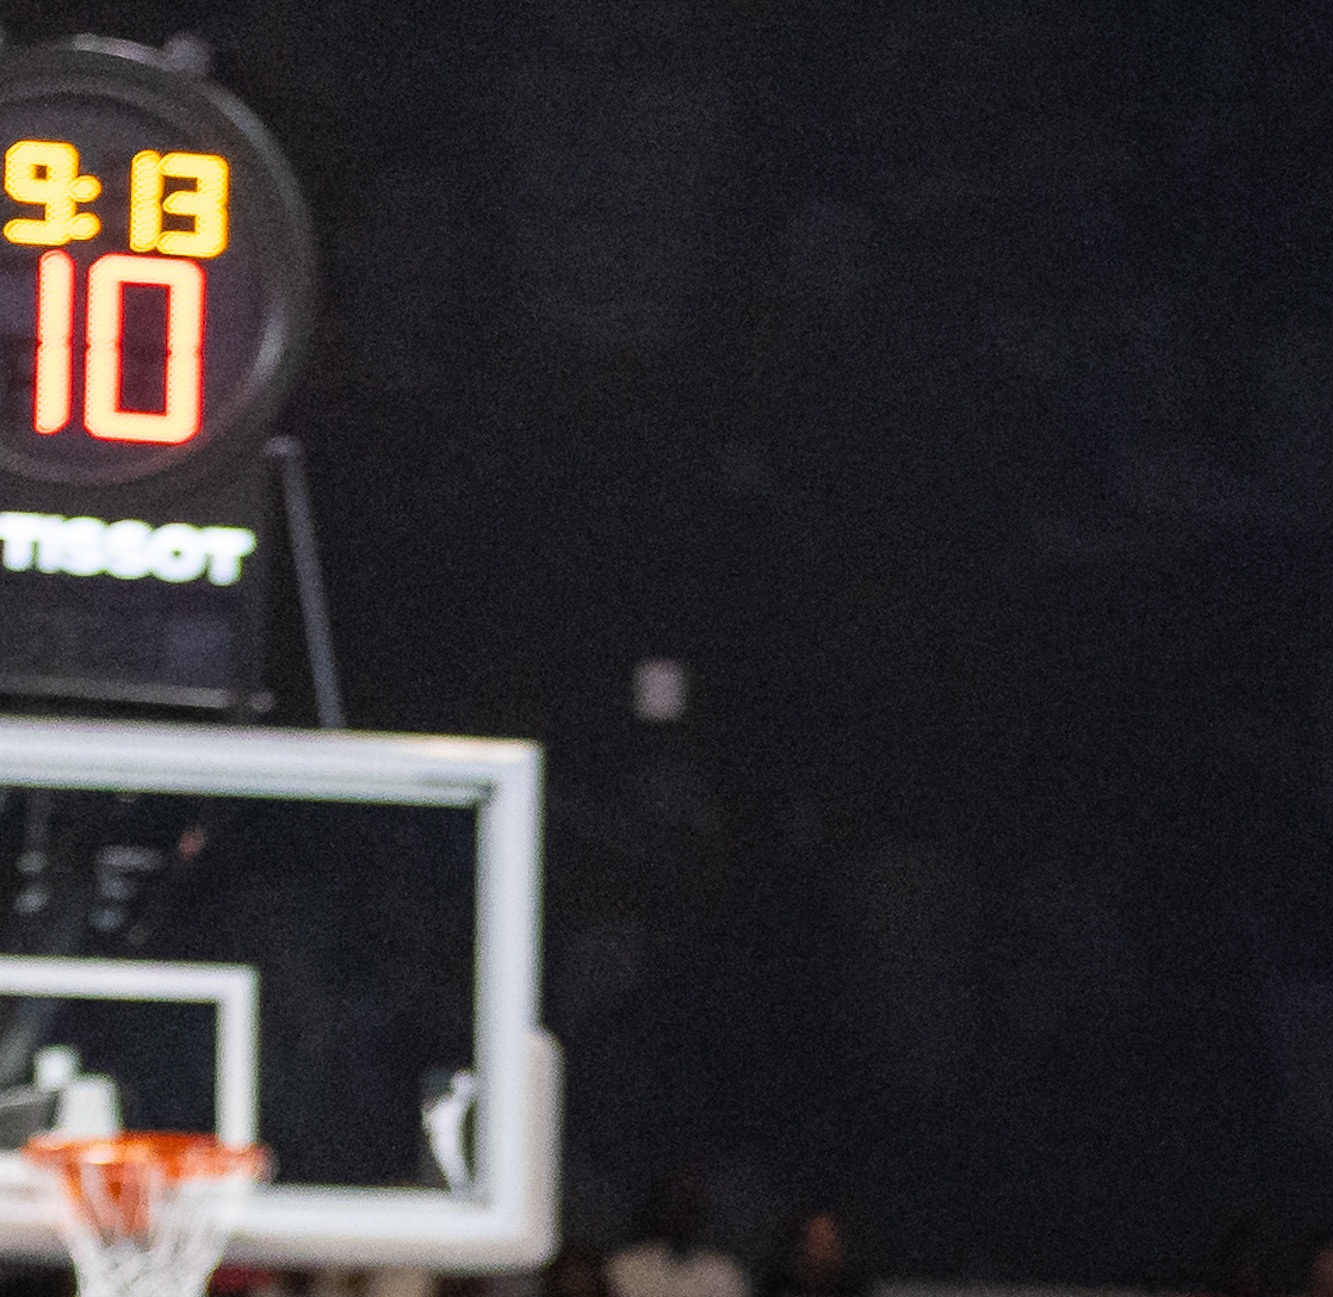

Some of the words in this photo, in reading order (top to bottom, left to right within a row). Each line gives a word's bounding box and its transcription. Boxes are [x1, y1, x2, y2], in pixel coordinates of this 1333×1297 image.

[3, 139, 230, 258] 9:13
[33, 249, 206, 444] 10
[0, 511, 257, 587] TISSOT
